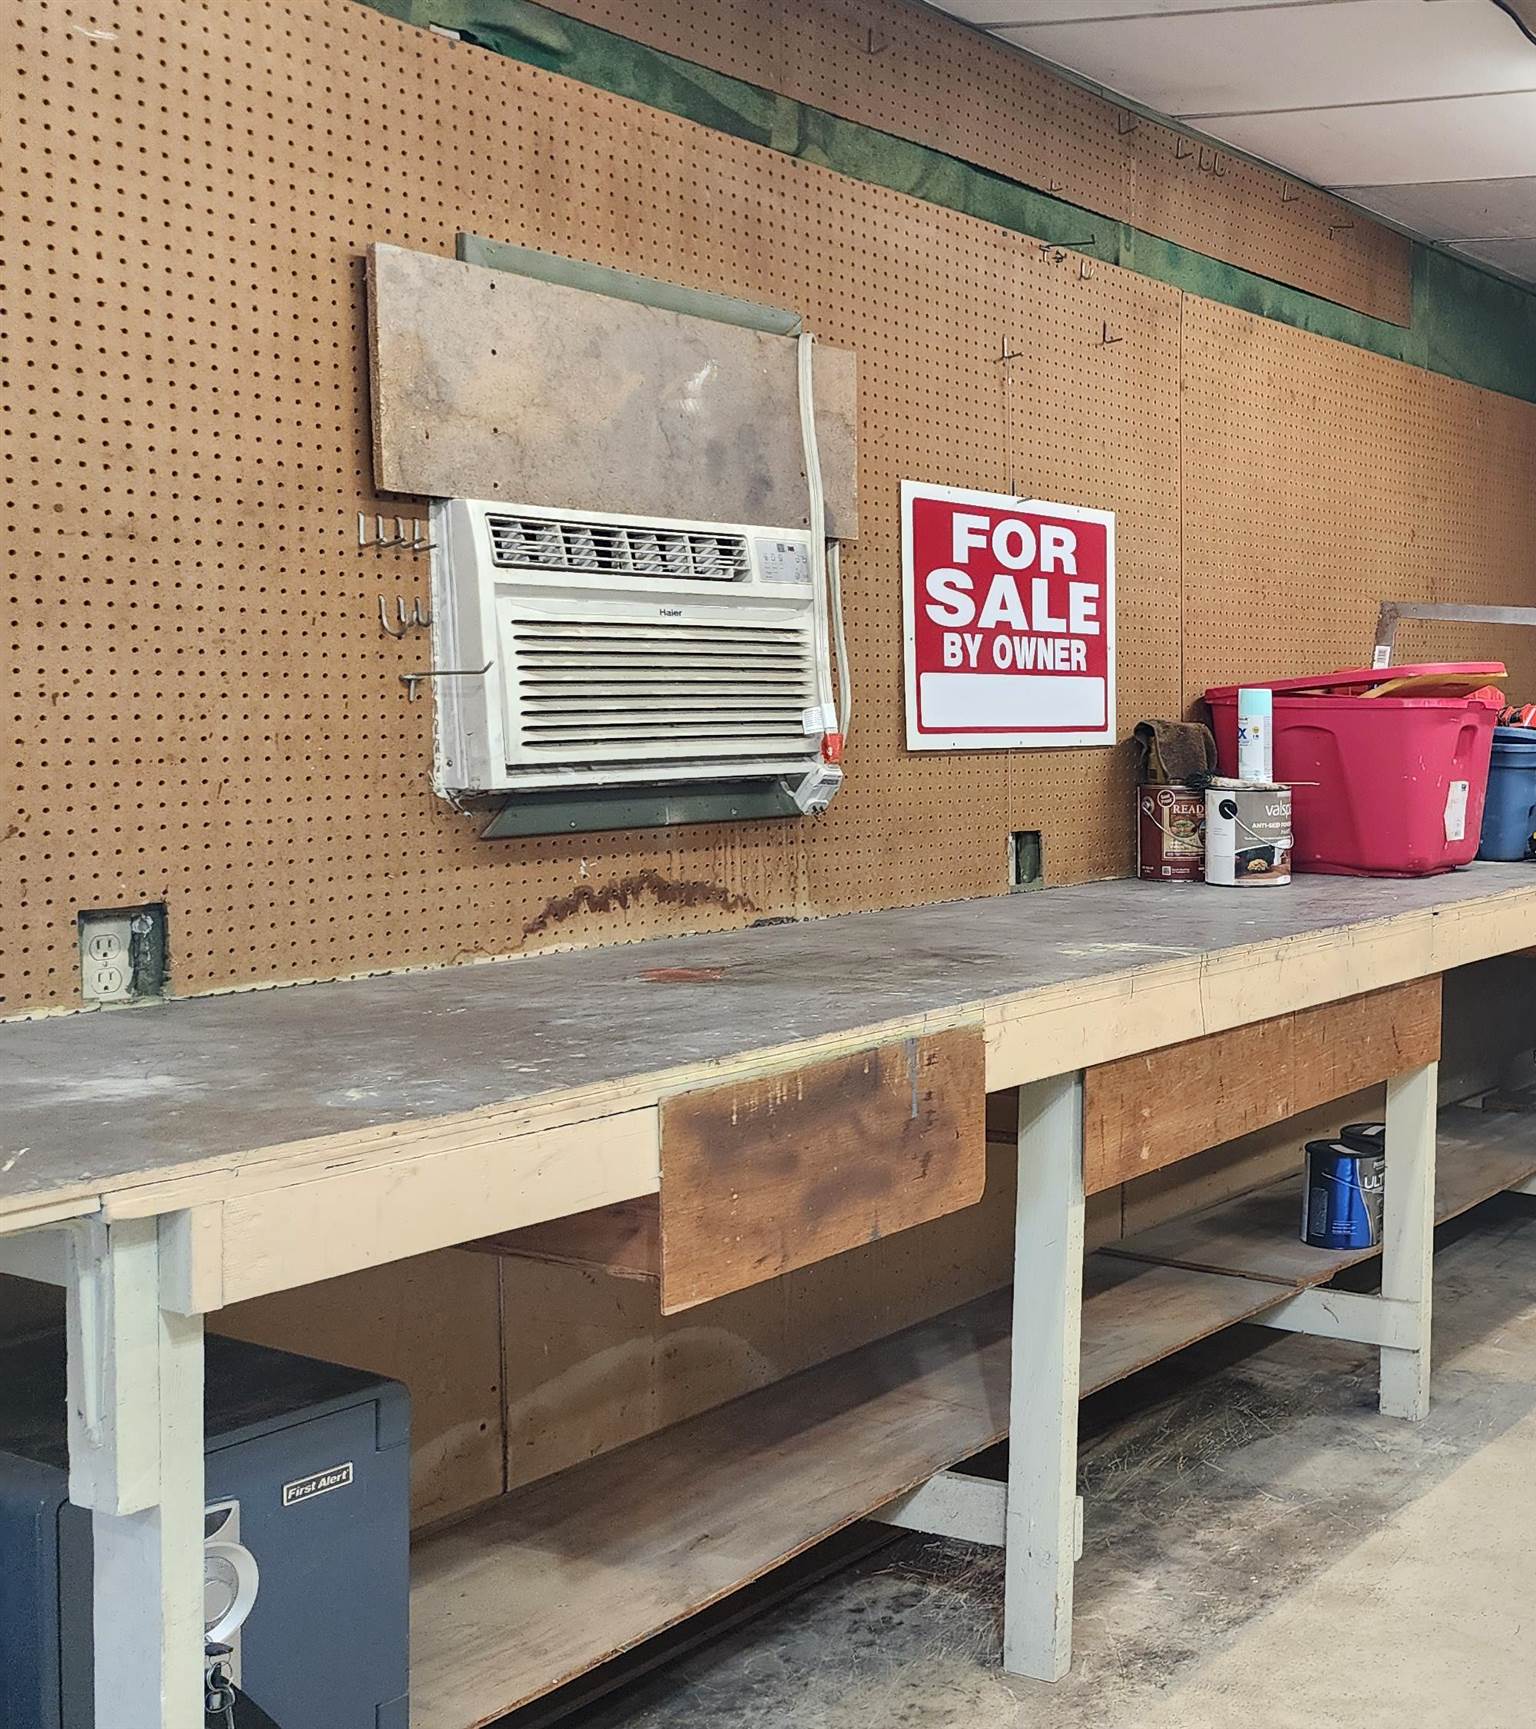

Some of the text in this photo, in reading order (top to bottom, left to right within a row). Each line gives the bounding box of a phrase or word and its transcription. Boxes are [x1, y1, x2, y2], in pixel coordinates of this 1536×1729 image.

[952, 511, 1077, 575] FOR
[925, 567, 1100, 635] SALE
[943, 632, 1087, 672] BY OWNER
[1173, 804, 1204, 814] READ
[1265, 799, 1291, 819] valsp
[1364, 1175, 1385, 1189] ULT
[288, 1471, 348, 1500] First Alert
